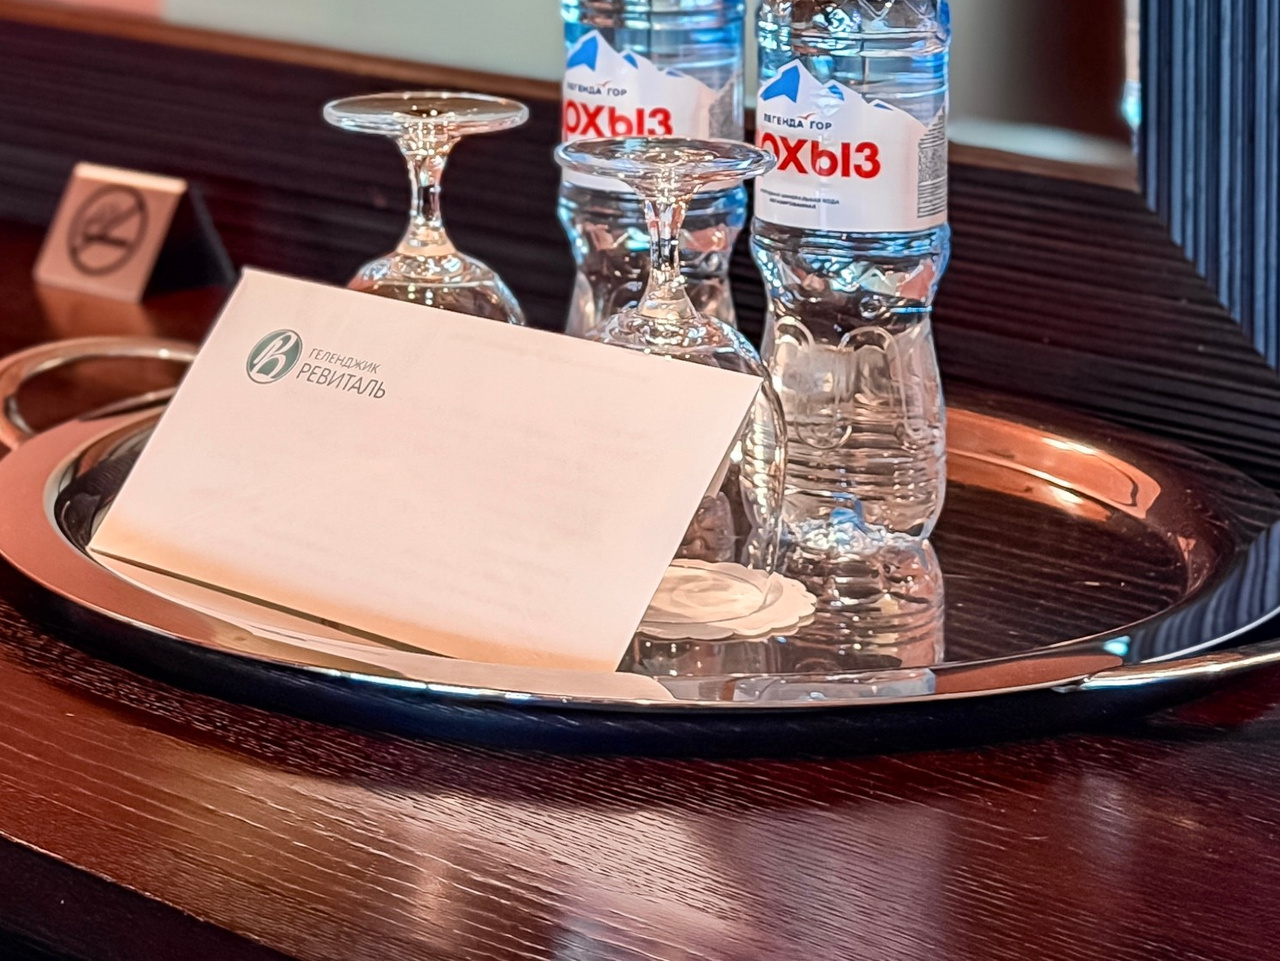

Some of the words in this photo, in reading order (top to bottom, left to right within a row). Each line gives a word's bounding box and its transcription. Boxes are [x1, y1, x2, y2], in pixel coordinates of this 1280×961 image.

[607, 87, 628, 97] ГОР
[809, 120, 832, 131] ГОР
[308, 347, 382, 375] ГЕЛЕНДЖИК
[295, 362, 387, 400] РЕВИТАЛЬ
